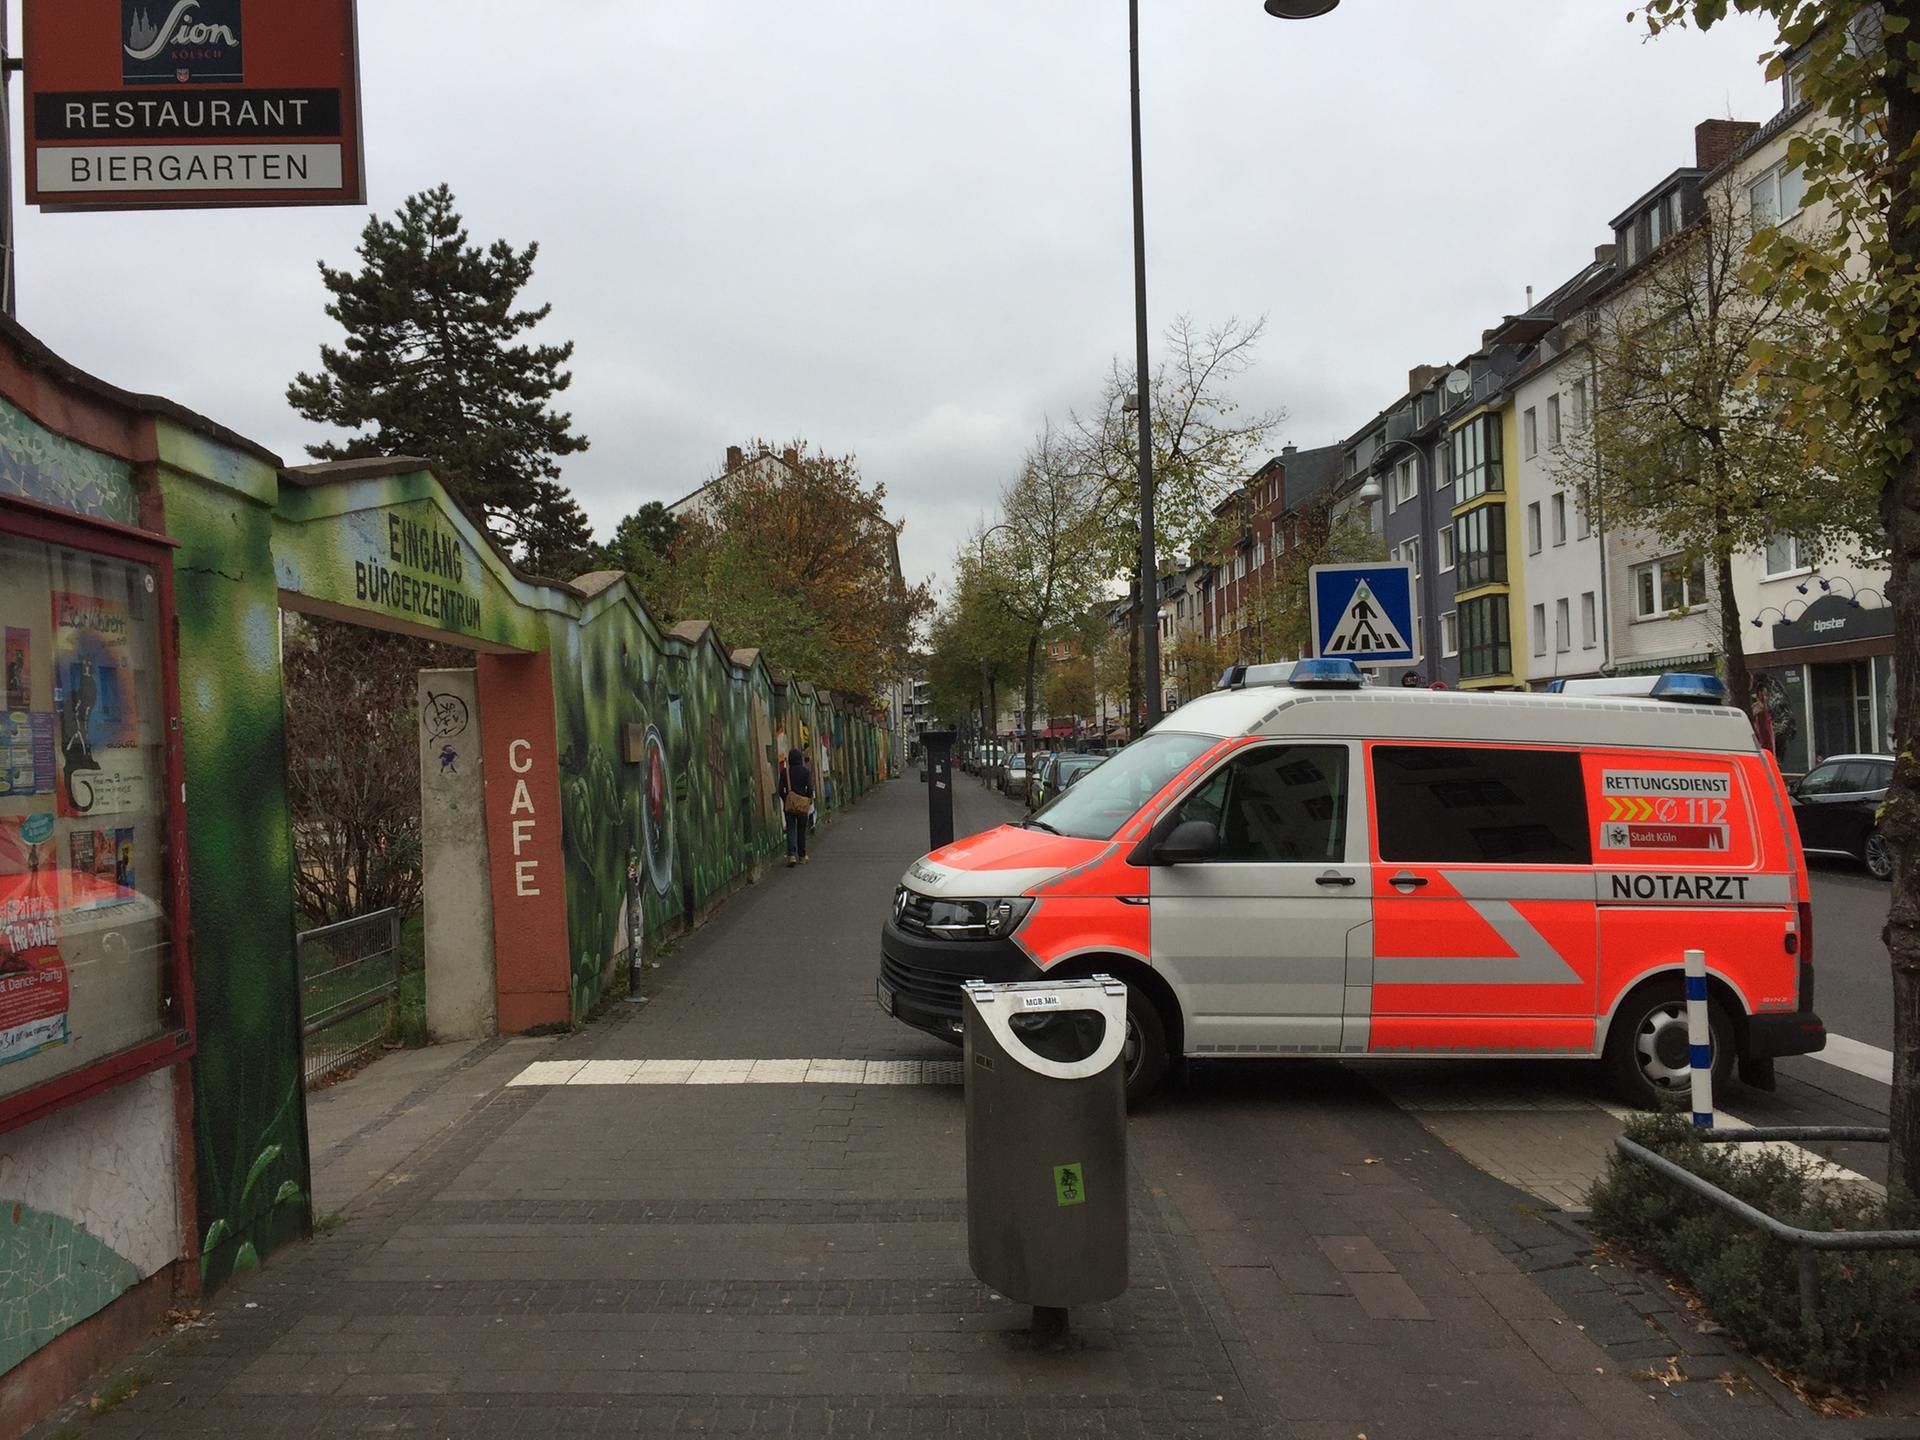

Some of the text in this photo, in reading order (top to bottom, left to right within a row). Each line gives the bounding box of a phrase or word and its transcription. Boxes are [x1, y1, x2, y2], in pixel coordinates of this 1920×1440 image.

[123, 0, 239, 60] Sion
[65, 100, 309, 129] RESTAURANT
[71, 154, 308, 182] BIERGARTEN
[388, 511, 463, 585] EINGANG
[355, 558, 482, 631] BÜRGERZENTRUM
[1605, 776, 1728, 793] RETTUNGSDIENST
[508, 738, 541, 897] CAFE
[1685, 799, 1727, 824] 112
[1631, 832, 1677, 842] Stadt Köln
[1611, 874, 1749, 900] NOTARZT
